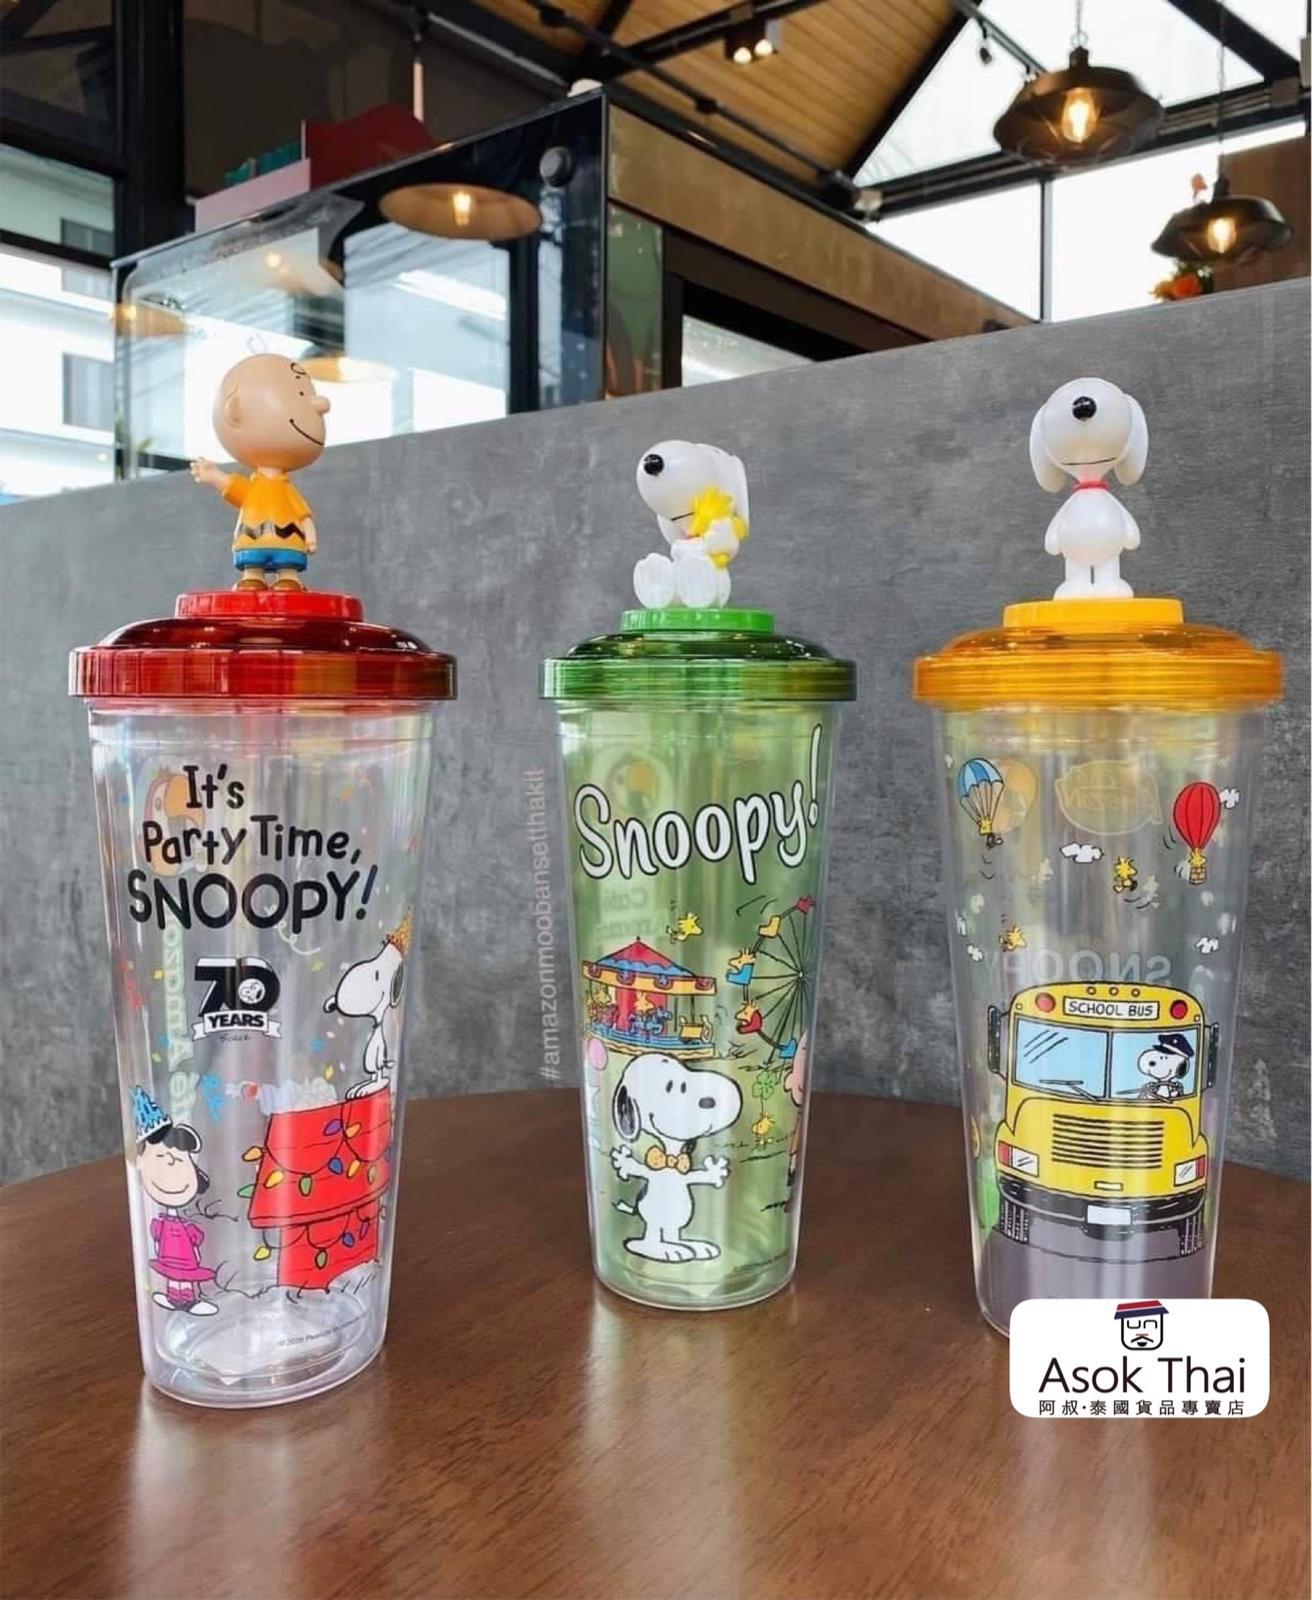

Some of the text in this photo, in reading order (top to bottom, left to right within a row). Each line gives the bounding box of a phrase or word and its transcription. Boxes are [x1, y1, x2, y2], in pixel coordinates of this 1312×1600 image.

[183, 763, 245, 809] It's
[573, 723, 823, 884] Snoopy!
[142, 814, 363, 865] Party Time,
[127, 865, 378, 934] SNOOPY!
[194, 955, 281, 1018] 70
[1068, 1000, 1154, 1017] SCHOOL BUS
[208, 1013, 265, 1028] YEARS
